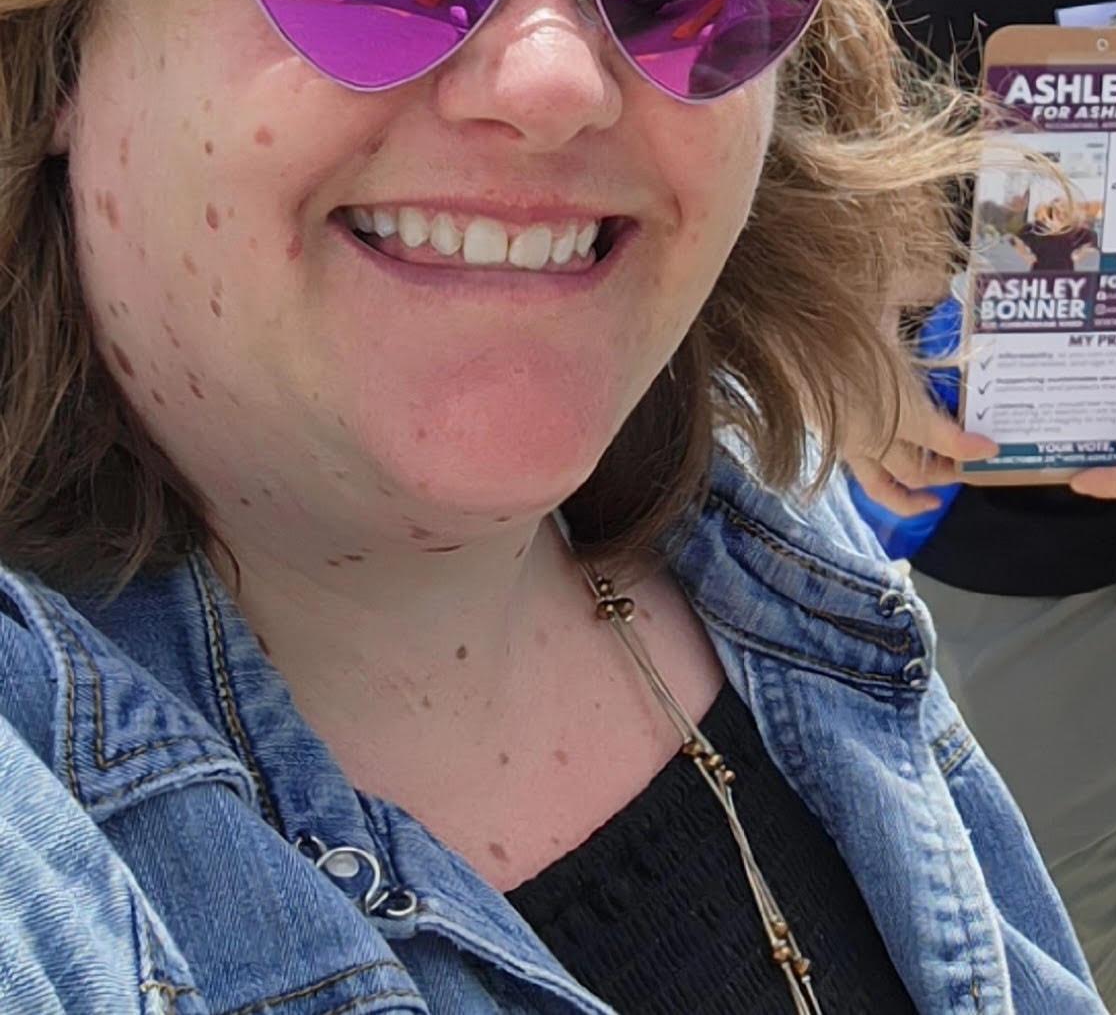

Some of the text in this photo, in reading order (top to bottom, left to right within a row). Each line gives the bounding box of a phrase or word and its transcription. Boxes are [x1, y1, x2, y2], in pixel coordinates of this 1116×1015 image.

[1032, 106, 1071, 120] FOR
[982, 277, 1088, 299] ASHLEY
[980, 298, 1087, 320] BONNER
[1068, 334, 1094, 347] MY
[1037, 441, 1074, 453] YOUR
